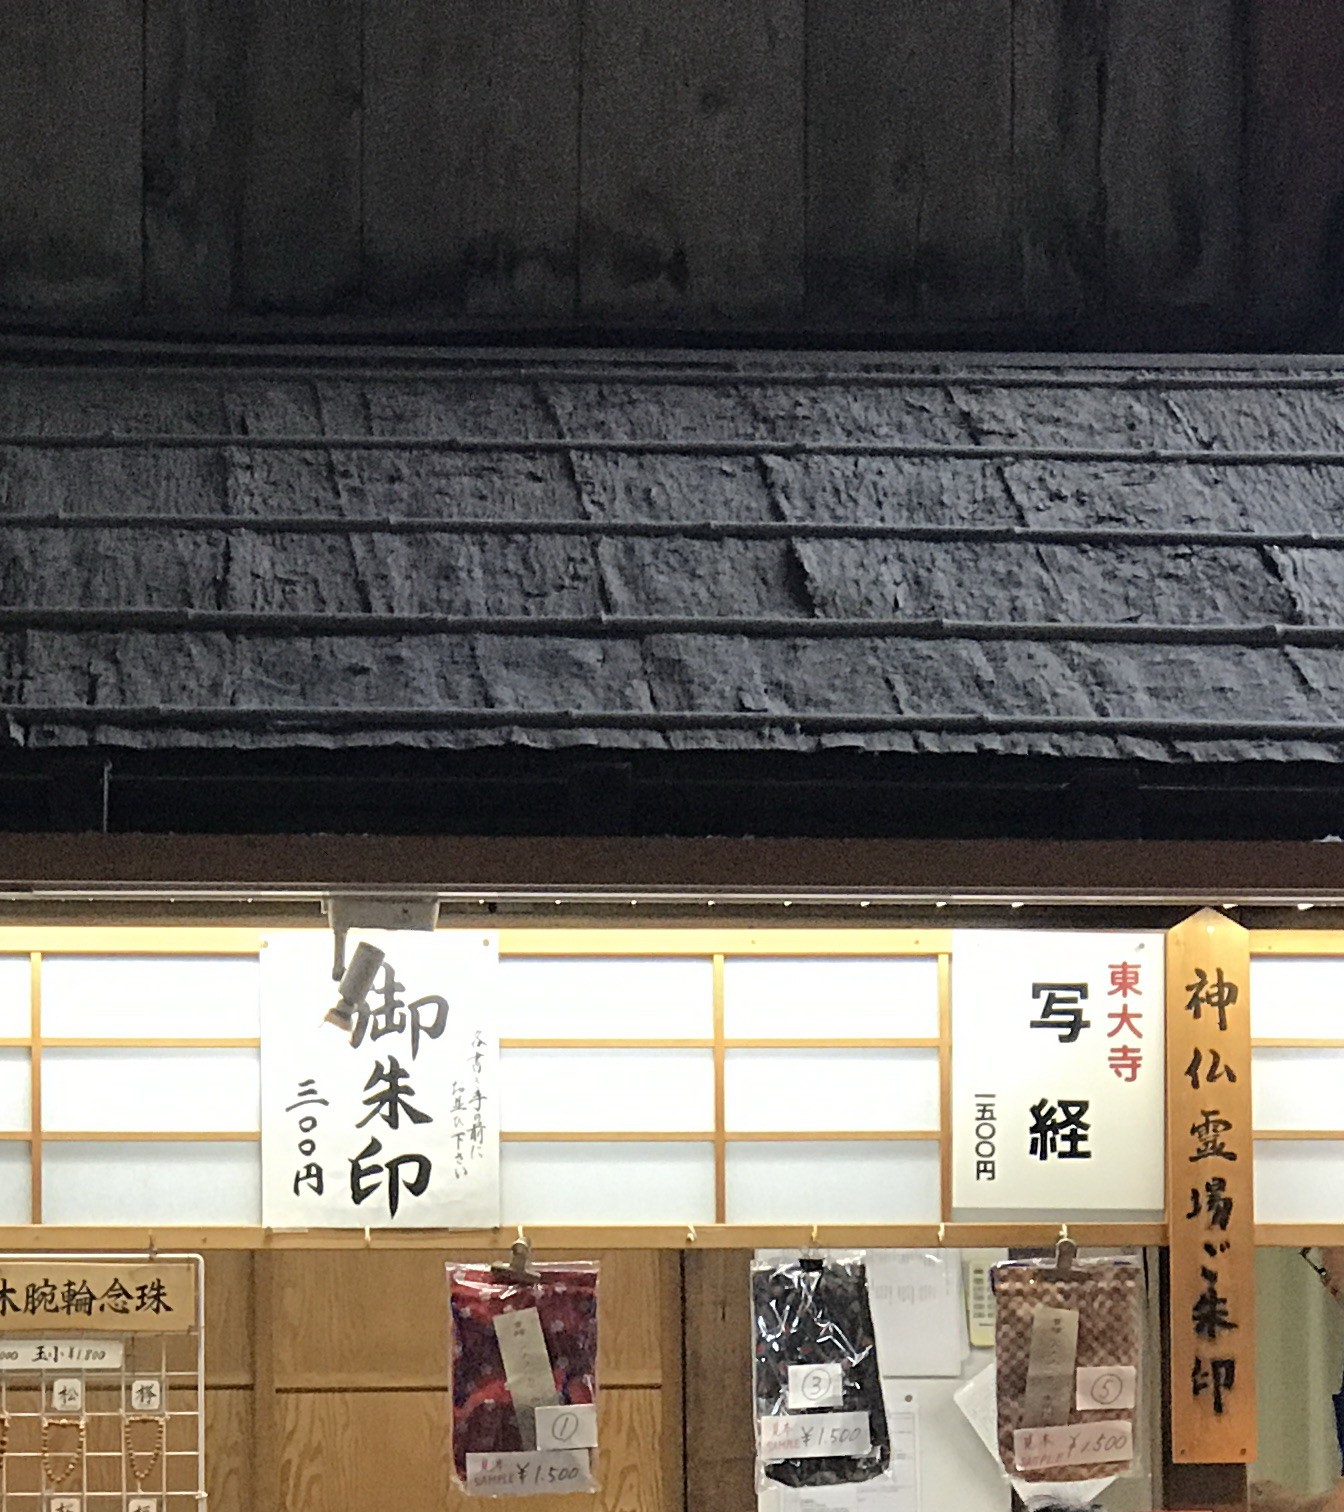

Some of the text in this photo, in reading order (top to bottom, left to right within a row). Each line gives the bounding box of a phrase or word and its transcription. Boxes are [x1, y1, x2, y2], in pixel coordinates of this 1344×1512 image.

[348, 961, 450, 1219] 御朱印
[1029, 982, 1092, 1161] 写経
[1107, 961, 1143, 1082] 東大寺
[57, 1384, 80, 1404] 松
